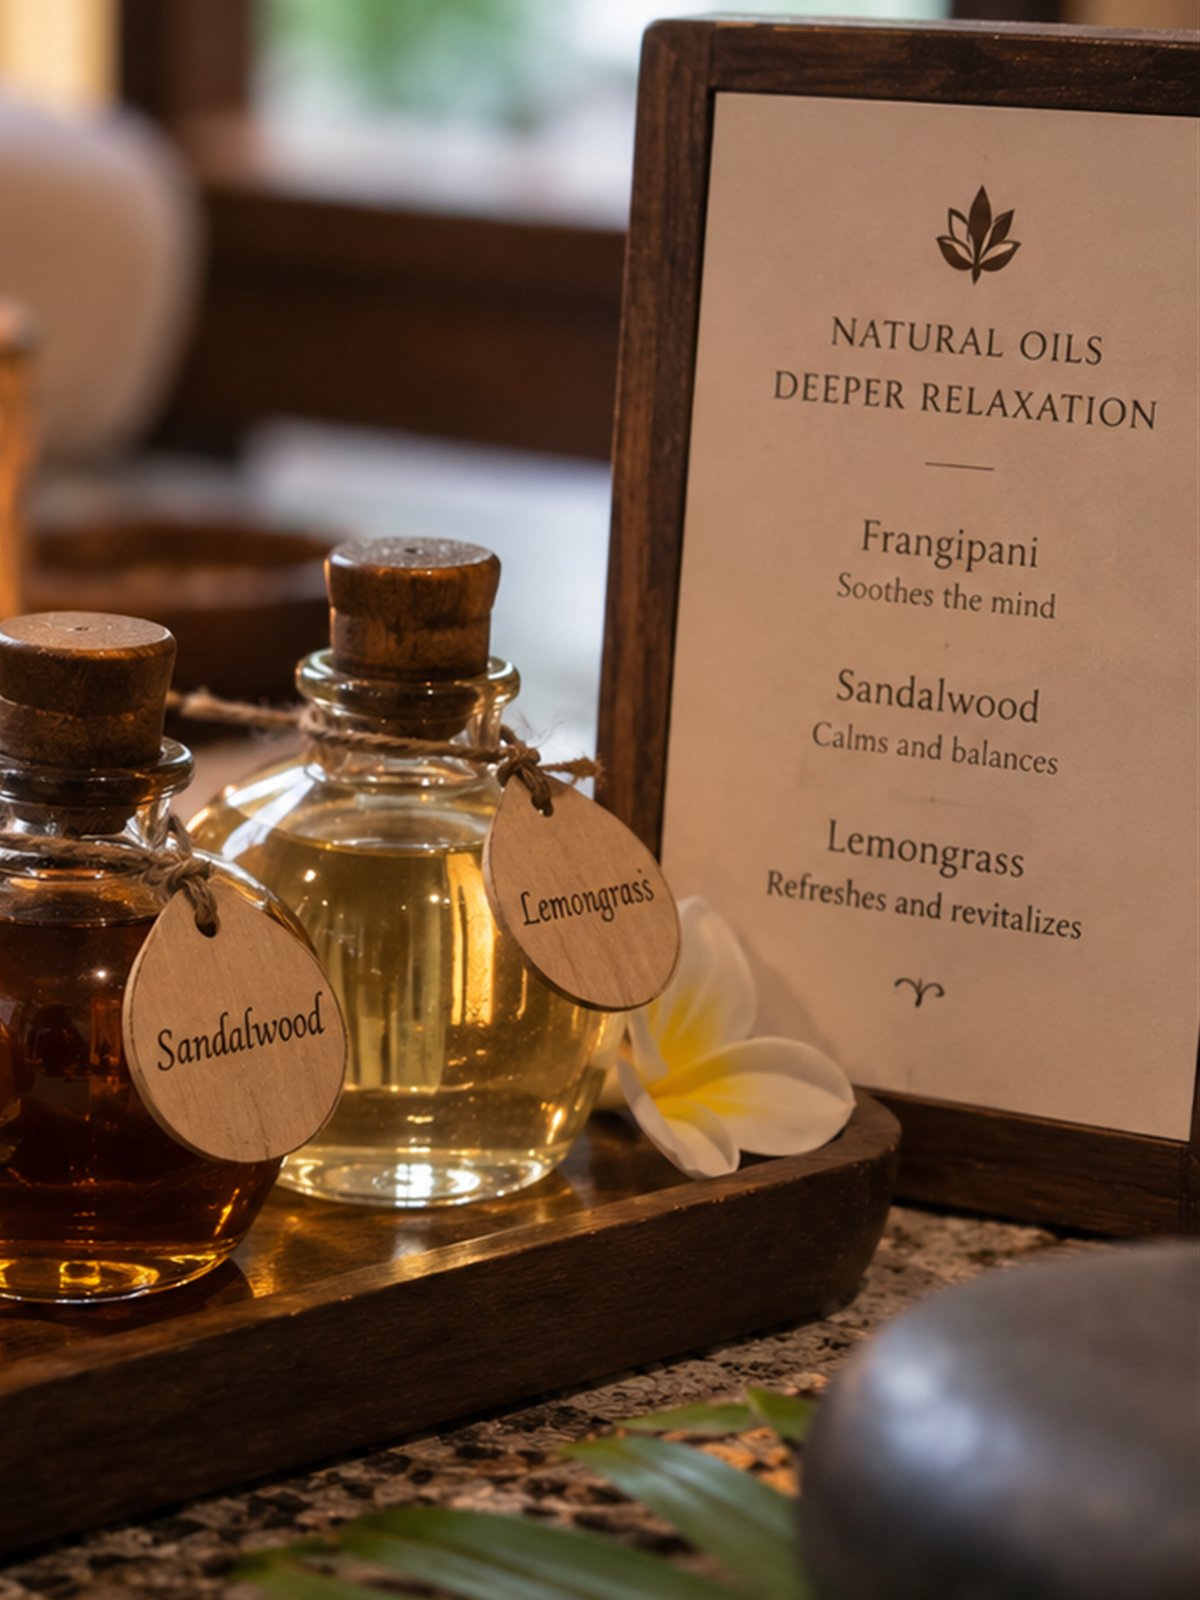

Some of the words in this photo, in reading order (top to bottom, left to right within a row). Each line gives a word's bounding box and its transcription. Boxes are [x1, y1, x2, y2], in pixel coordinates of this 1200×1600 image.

[831, 316, 1004, 358] NATURAL
[1019, 330, 1103, 365] OILS
[774, 370, 905, 410] DEEPER
[920, 382, 1158, 430] RELAXATION
[861, 519, 1039, 573] Frangipani
[836, 572, 934, 607] Soothes
[943, 583, 982, 612] the
[991, 592, 1056, 620] mind
[836, 669, 1040, 723] Sandalwood
[812, 721, 889, 754] Calms
[896, 734, 942, 761] and
[951, 736, 1059, 775] balances
[827, 819, 1025, 879] Lemongrass
[520, 878, 654, 926] Lemongrass
[766, 870, 887, 912] Refreshes
[894, 892, 942, 920] and
[950, 902, 1083, 940] revitalizes
[157, 991, 325, 1071] Sandalwood
